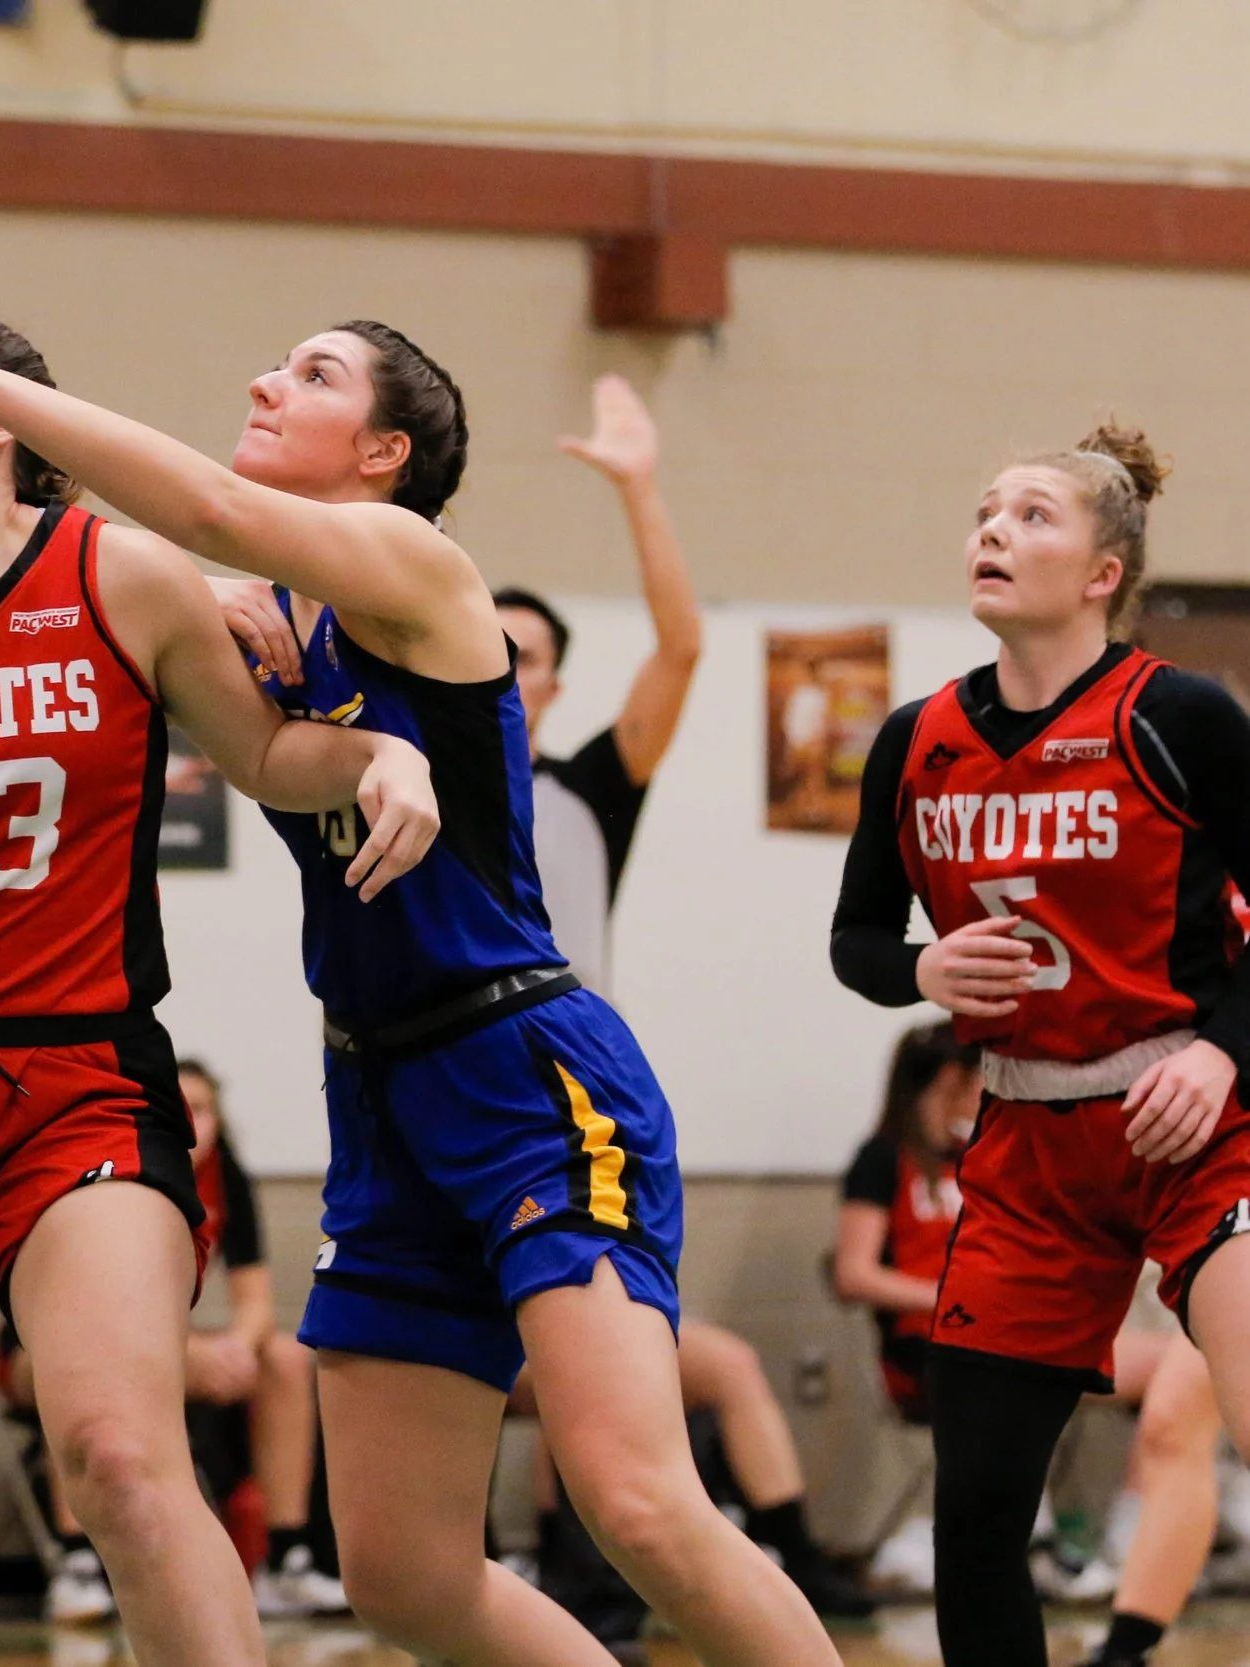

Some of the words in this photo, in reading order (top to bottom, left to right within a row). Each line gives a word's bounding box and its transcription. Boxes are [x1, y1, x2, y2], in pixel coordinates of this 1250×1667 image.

[11, 612, 78, 632] PACWEST
[915, 789, 1118, 863] COYOTES
[969, 876, 1071, 991] 5
[511, 1207, 546, 1230] adidas
